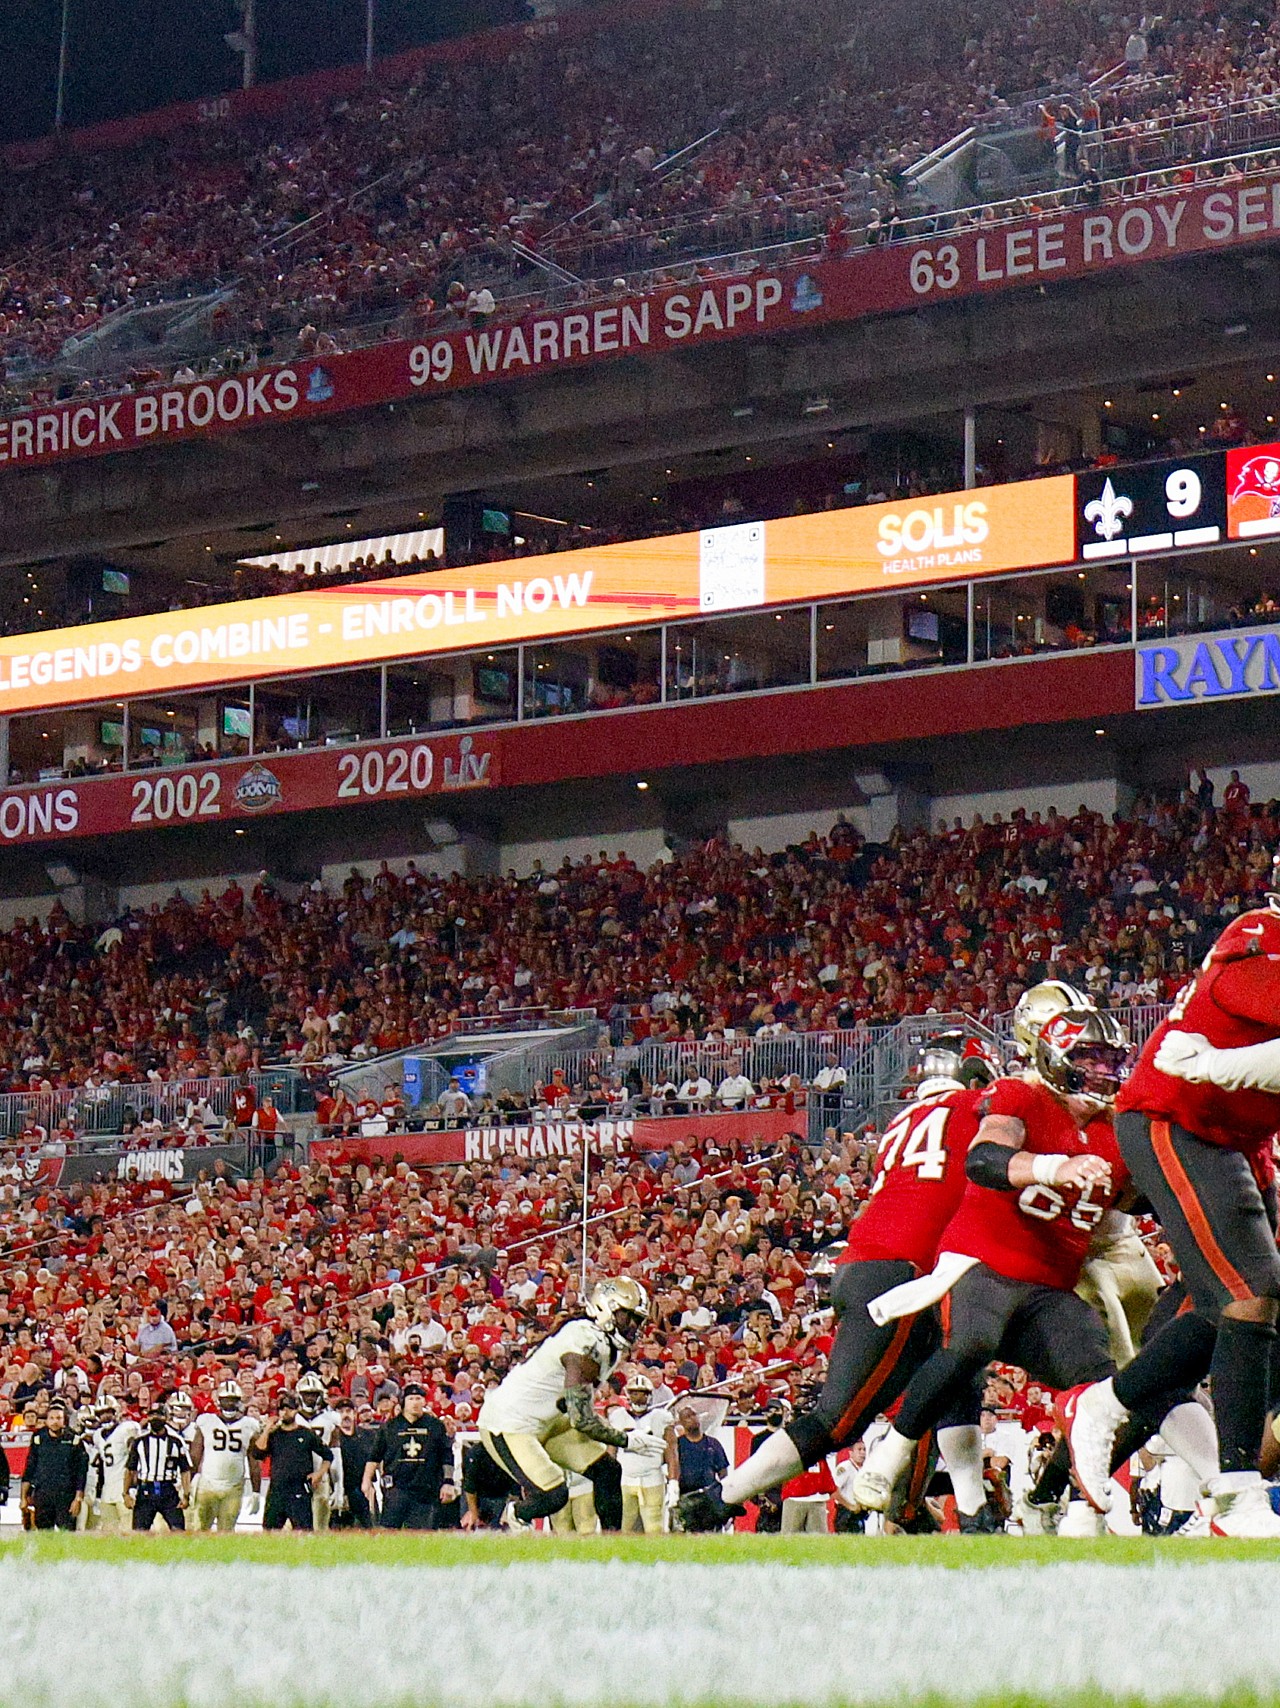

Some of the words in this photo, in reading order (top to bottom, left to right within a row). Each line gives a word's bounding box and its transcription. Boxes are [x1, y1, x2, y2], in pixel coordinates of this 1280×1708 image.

[909, 248, 960, 294] 63
[976, 222, 1067, 283] LEE
[1083, 201, 1189, 263] ROY
[409, 341, 454, 386] 99
[467, 303, 650, 373] WARREN
[664, 278, 782, 339] SAPP
[135, 370, 299, 436] BROOKS
[1165, 468, 1201, 518] 9
[876, 501, 989, 556] SOLIS
[883, 556, 935, 575] HEALTH
[938, 547, 983, 566] PLANS
[150, 614, 308, 669] COMBINE
[341, 589, 486, 641] ENROLL
[497, 570, 594, 619] NOW
[337, 744, 434, 798] 2020
[1, 790, 79, 839] ONS
[131, 772, 221, 823] 2002
[876, 1106, 950, 1183] 74
[212, 1427, 243, 1453] 95
